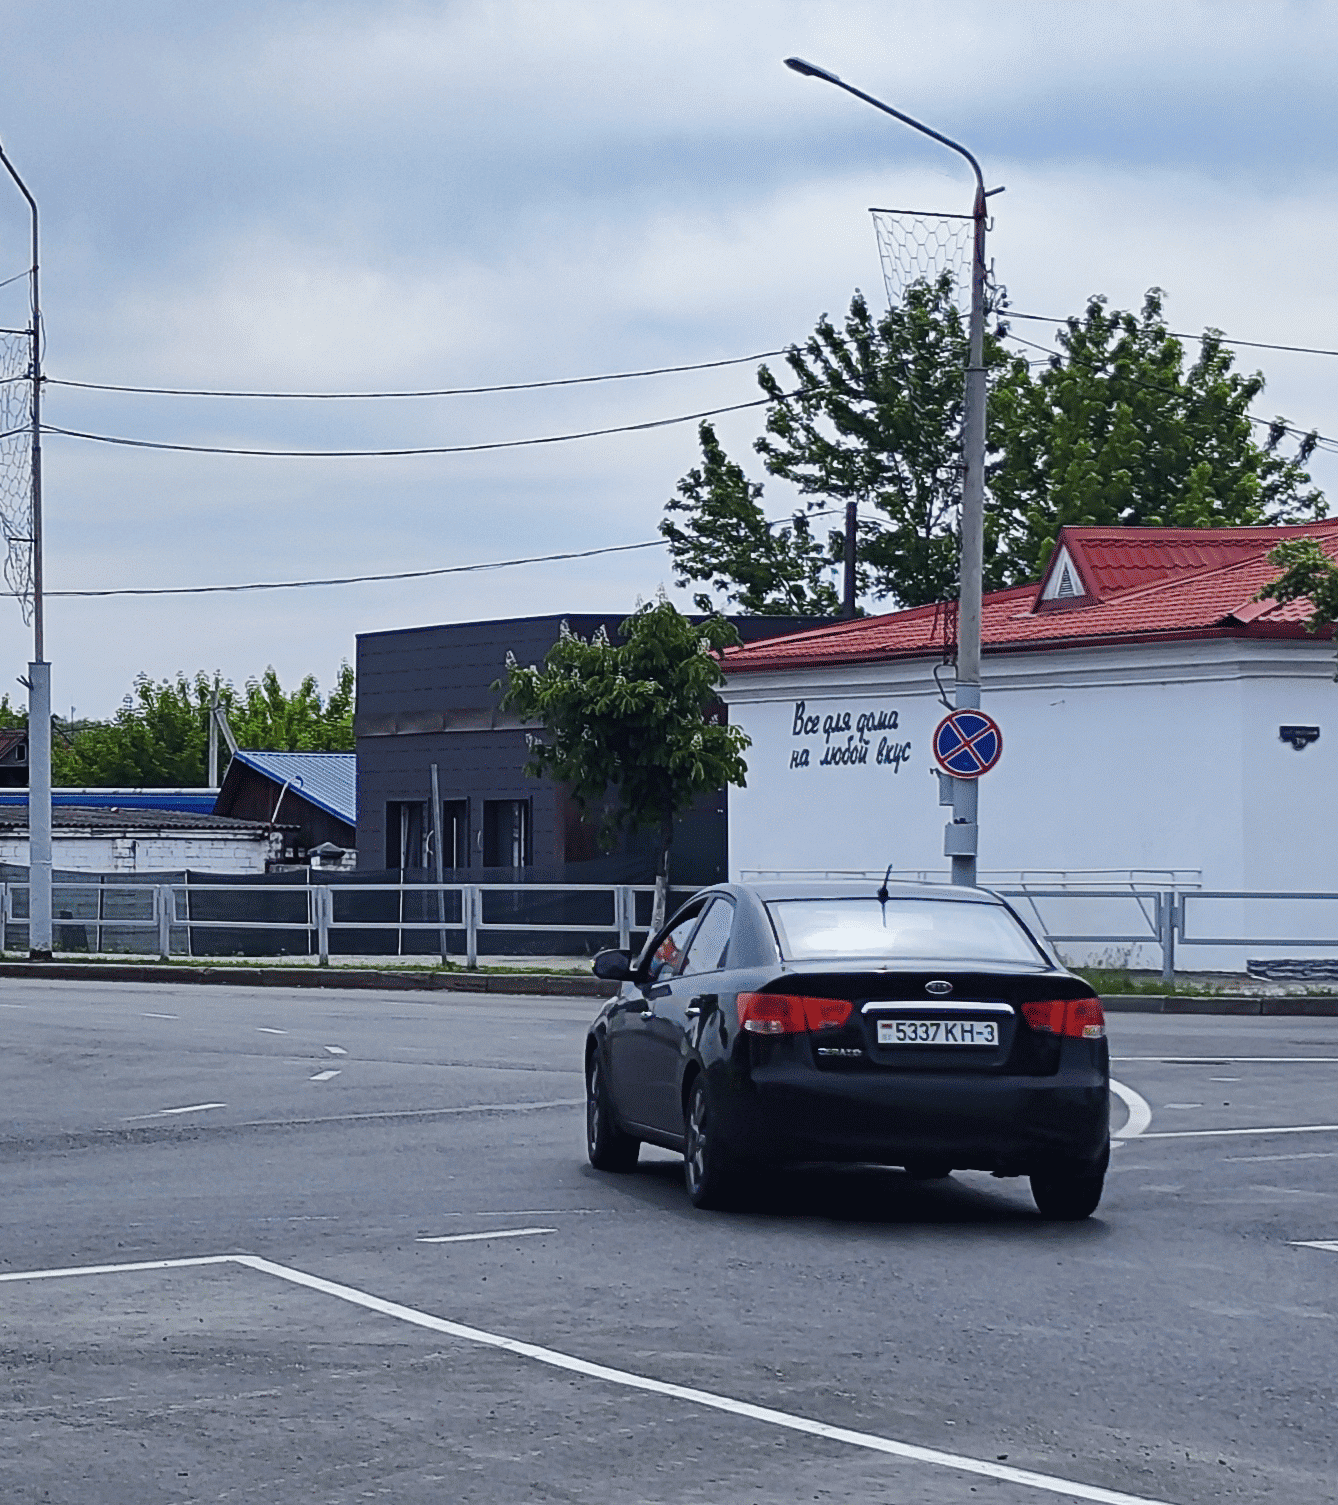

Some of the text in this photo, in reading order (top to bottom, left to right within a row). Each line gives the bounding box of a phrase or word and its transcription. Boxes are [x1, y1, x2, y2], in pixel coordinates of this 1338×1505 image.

[792, 700, 899, 745] Все для дома
[789, 735, 911, 774] на любой вкус
